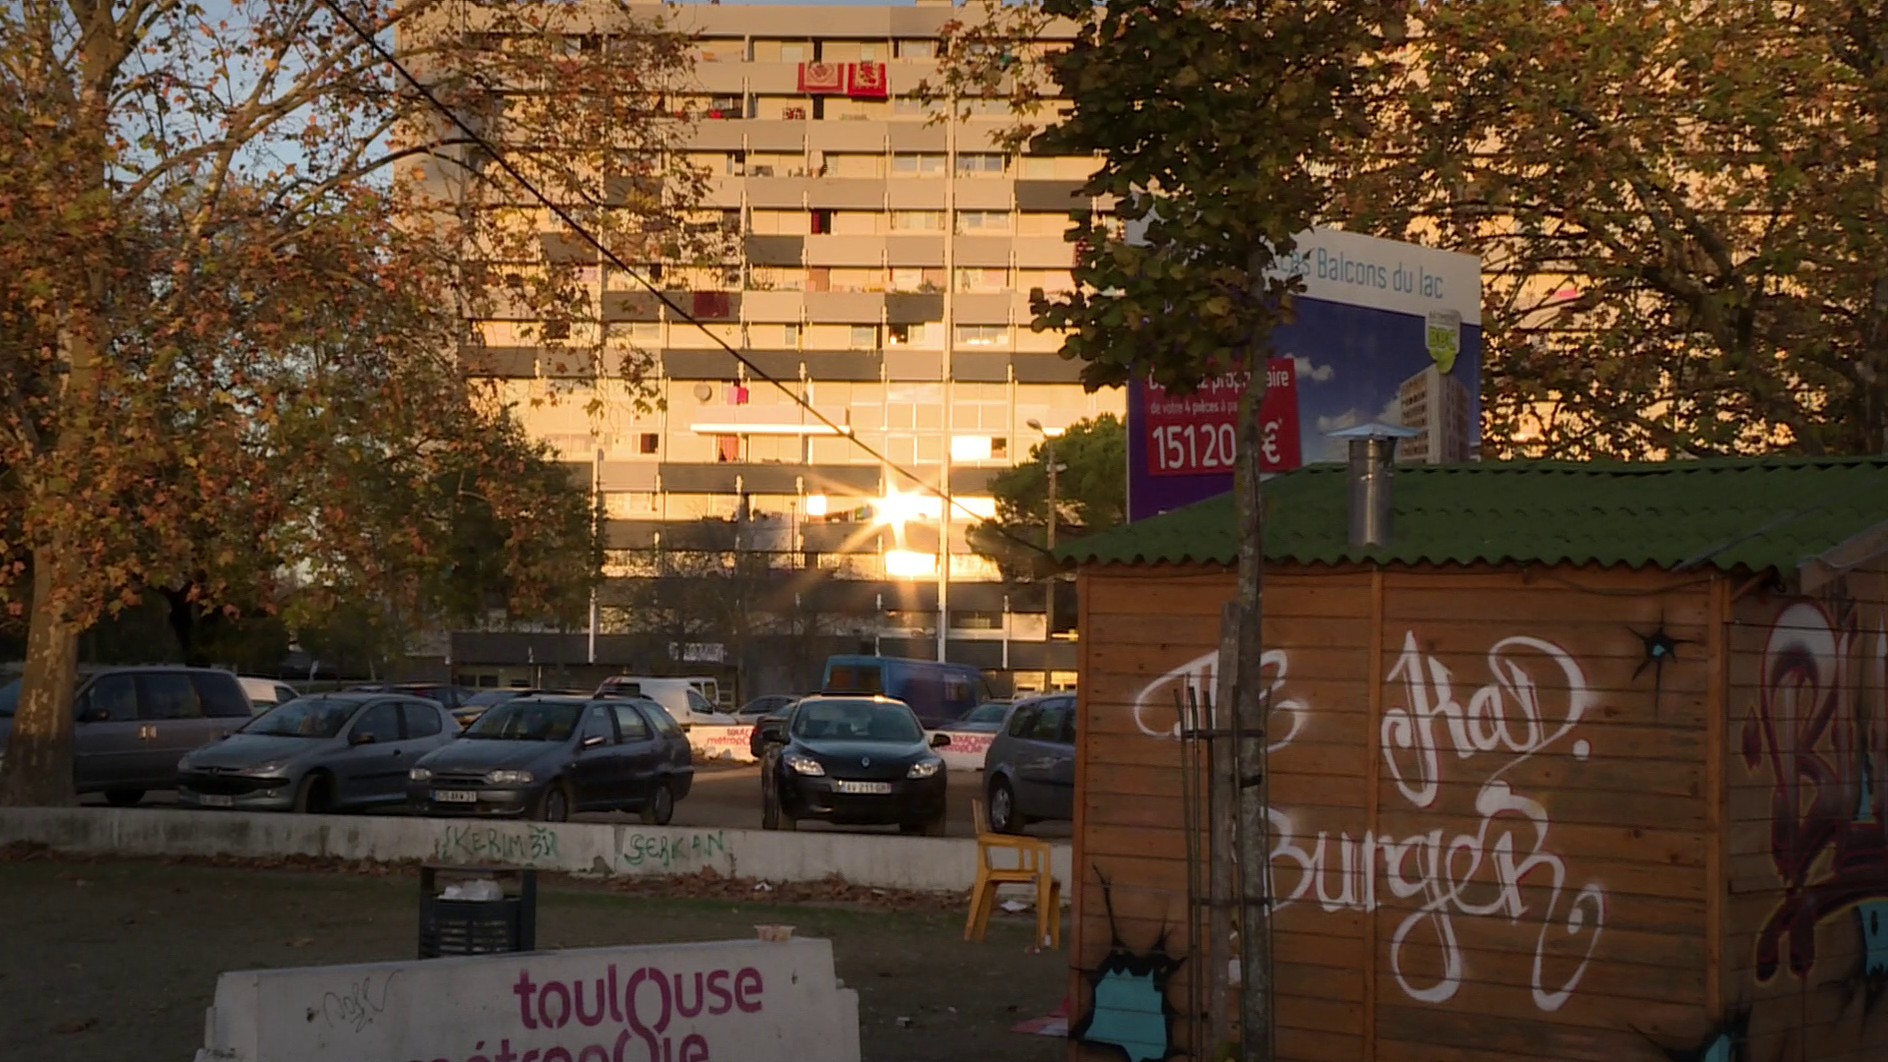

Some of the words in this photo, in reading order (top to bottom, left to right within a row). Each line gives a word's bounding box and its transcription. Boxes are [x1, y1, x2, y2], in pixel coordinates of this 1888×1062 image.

[1317, 246, 1387, 290] Balcons
[1392, 262, 1413, 294] du
[1419, 265, 1444, 299] lac
[1150, 402, 1161, 414] de
[1162, 401, 1183, 414] votre
[1185, 400, 1191, 412] 4
[1192, 400, 1219, 415] pièces
[1152, 423, 1238, 469] 15120
